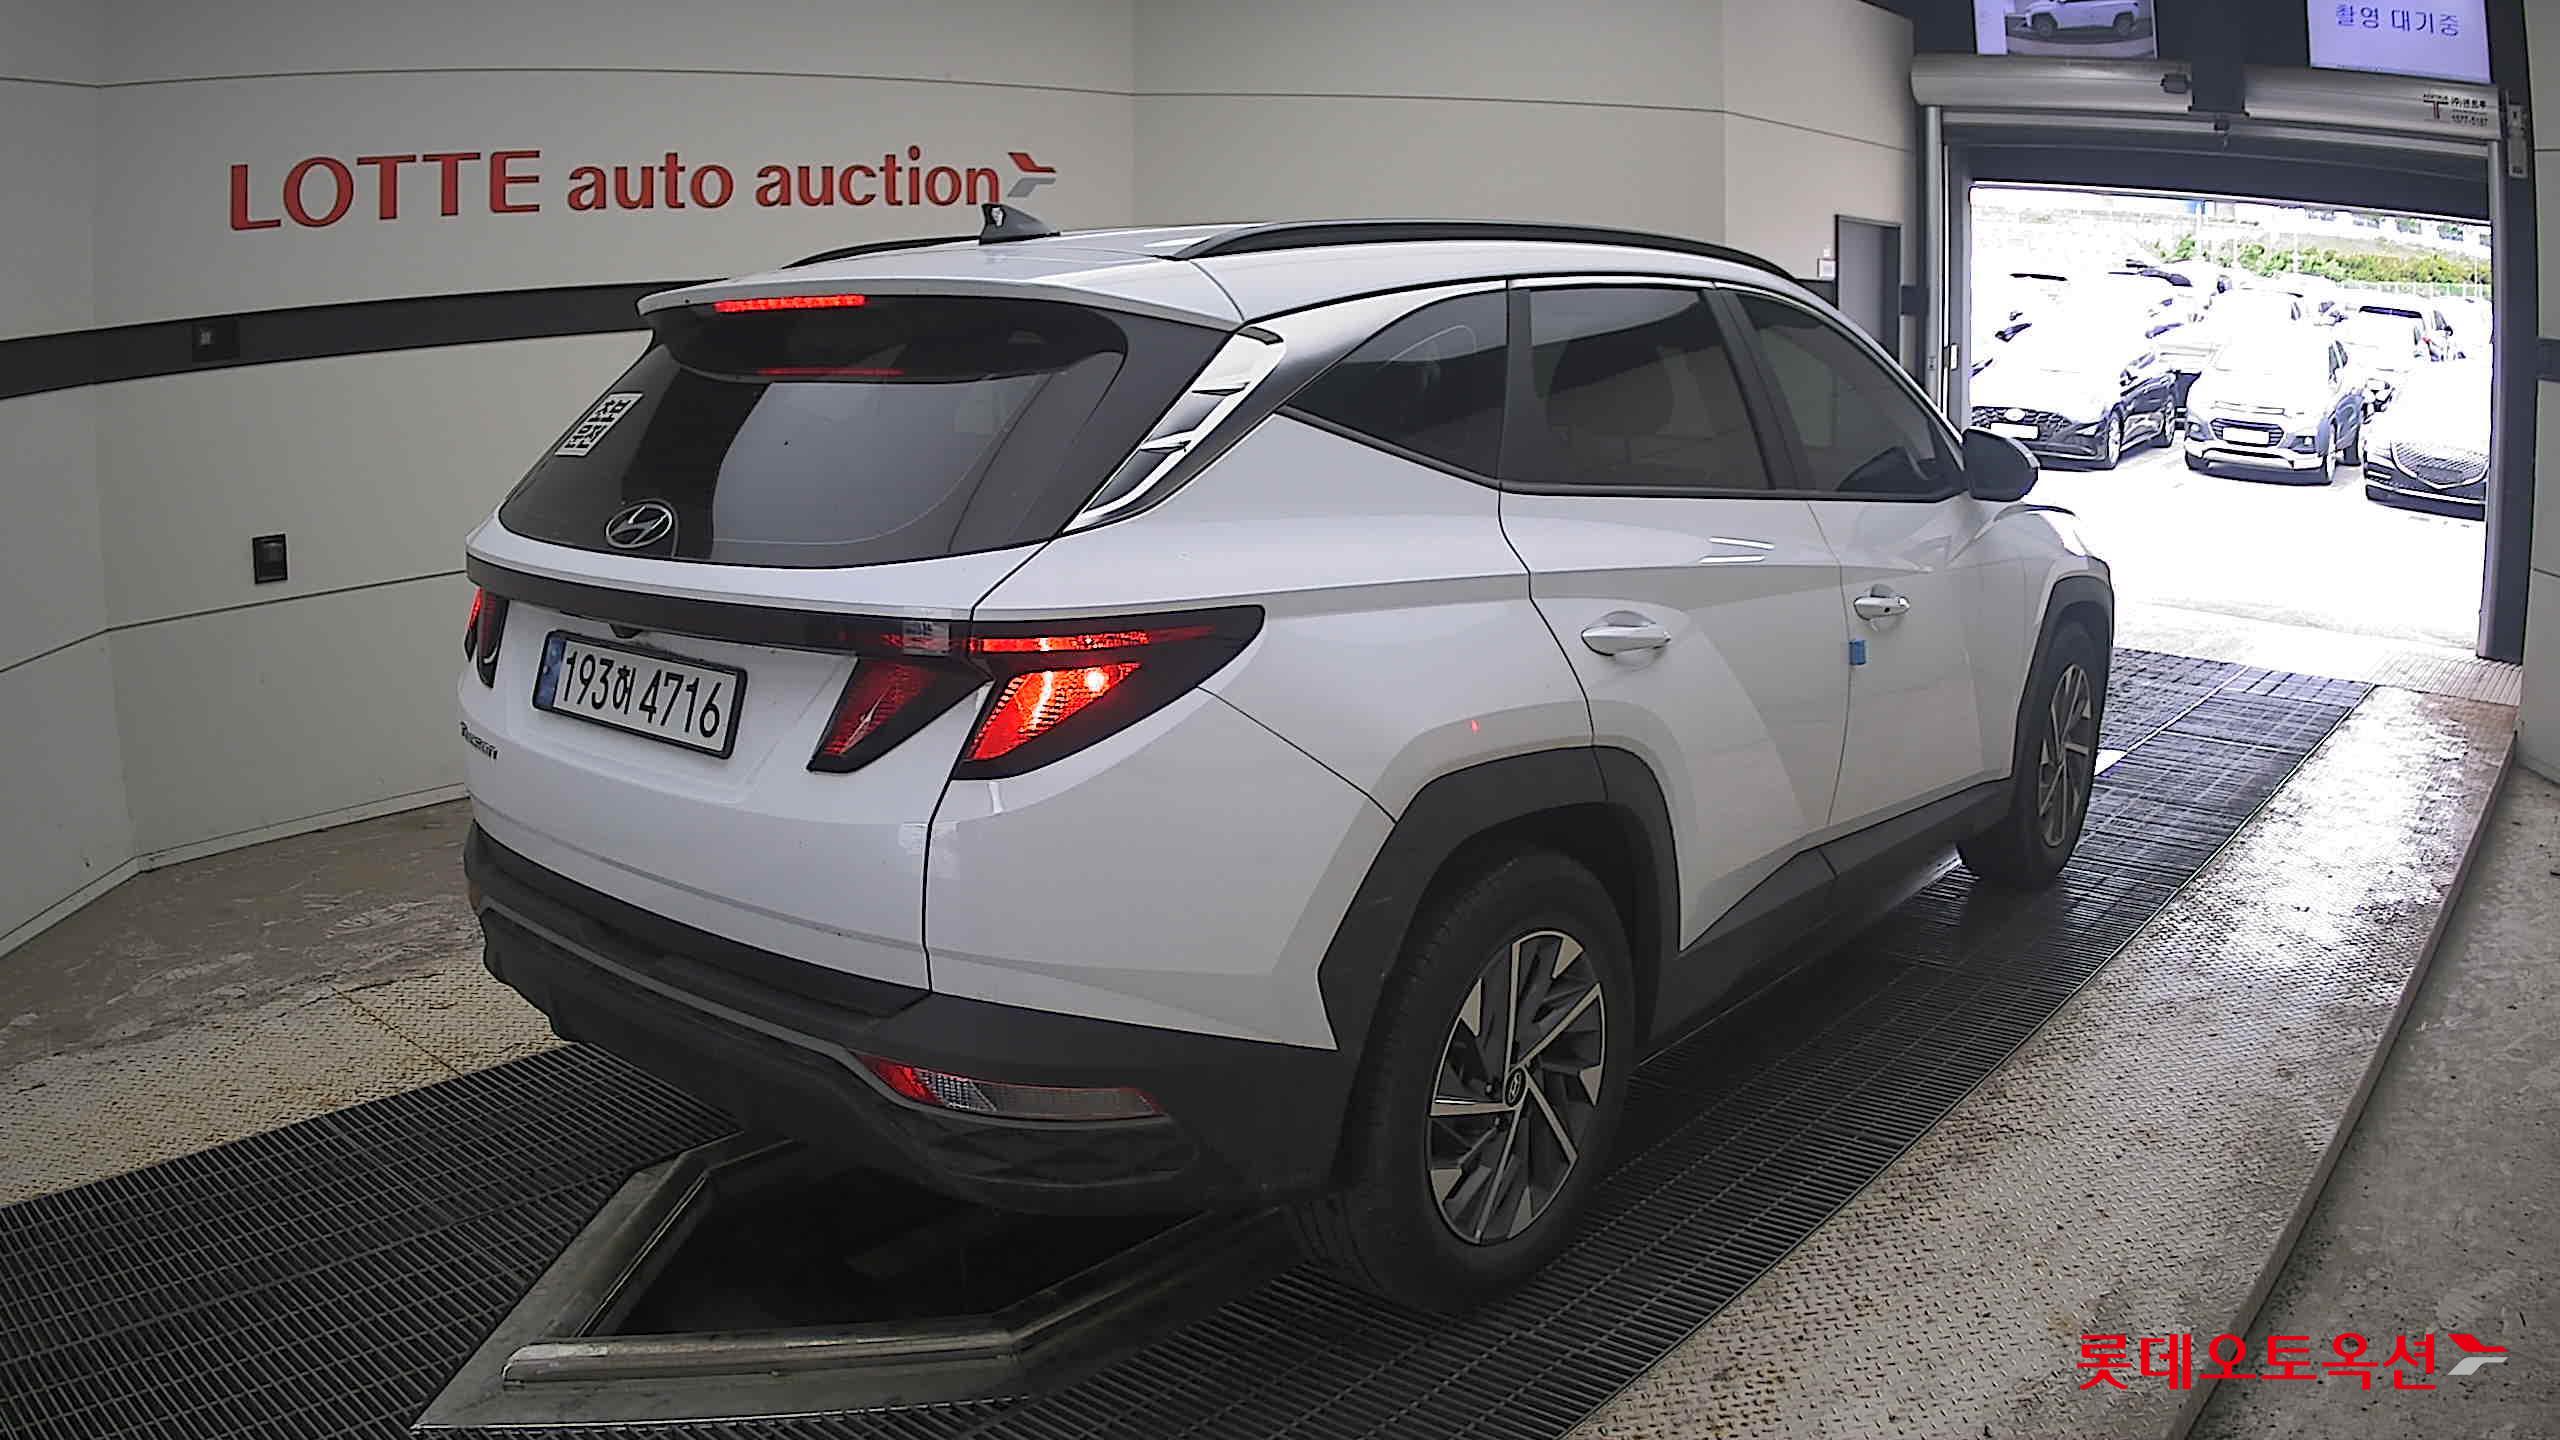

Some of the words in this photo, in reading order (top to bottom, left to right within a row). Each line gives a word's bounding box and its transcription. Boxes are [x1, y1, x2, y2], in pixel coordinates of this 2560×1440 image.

[2335, 4, 2380, 29] 촬영
[231, 150, 541, 230] LOTTE
[567, 151, 734, 211] auto
[755, 145, 1001, 208] auction
[563, 650, 637, 715] 193허
[638, 669, 723, 738] 4716
